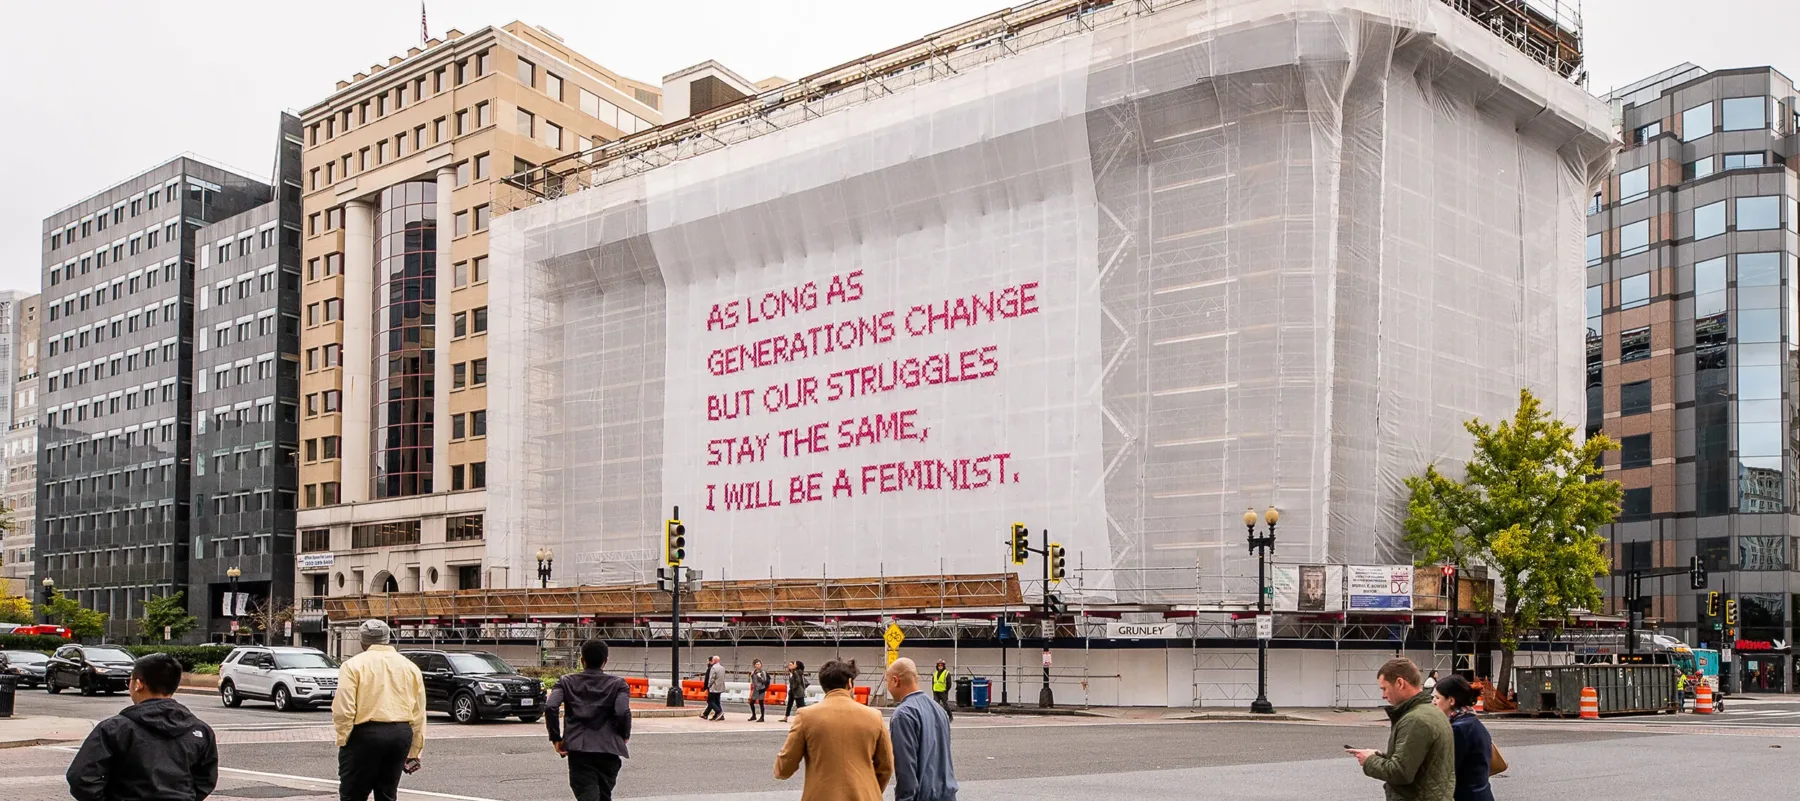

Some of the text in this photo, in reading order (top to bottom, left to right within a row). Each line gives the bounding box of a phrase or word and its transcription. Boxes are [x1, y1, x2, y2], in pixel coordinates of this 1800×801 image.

[707, 269, 863, 331] AS LONG AS
[707, 281, 1039, 376] GENERATIONS CHANGE
[707, 345, 998, 421] BUT OUR STRUGGLES
[707, 409, 928, 466] STAY THE SAME,
[706, 453, 1019, 511] I WILL BE A FEMINIST.
[1391, 581, 1409, 594] DC
[1118, 626, 1165, 635] GRUNLEY
[1735, 640, 1771, 650] Wawa
